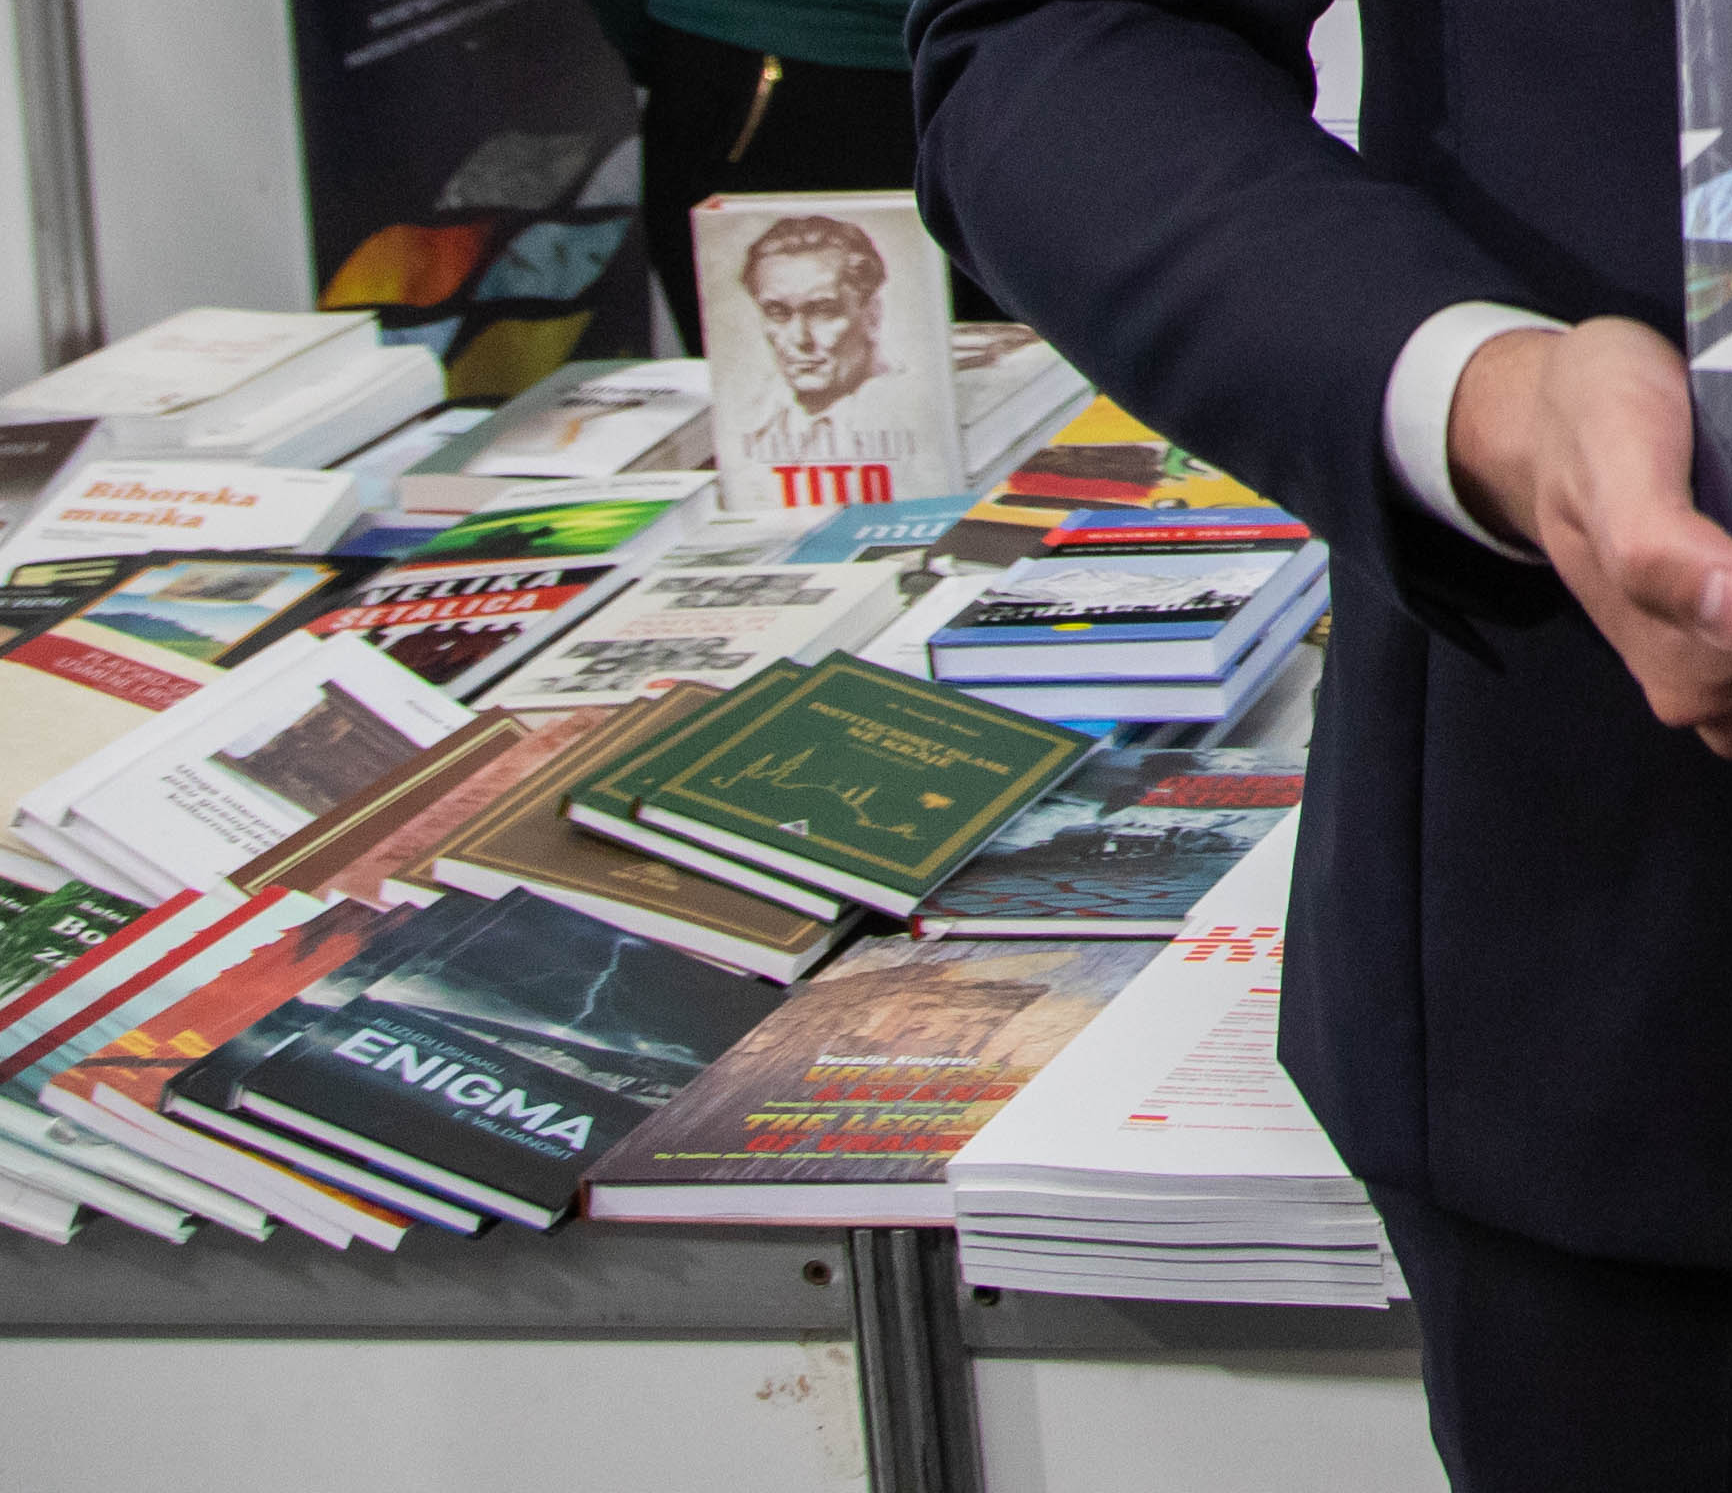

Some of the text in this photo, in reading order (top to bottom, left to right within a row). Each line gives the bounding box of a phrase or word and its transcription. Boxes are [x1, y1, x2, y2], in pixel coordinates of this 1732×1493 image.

[80, 480, 260, 508] Bihorska
[57, 507, 206, 529] muzika
[360, 570, 566, 606] VELIKA
[331, 1027, 595, 1153] ENIGMA
